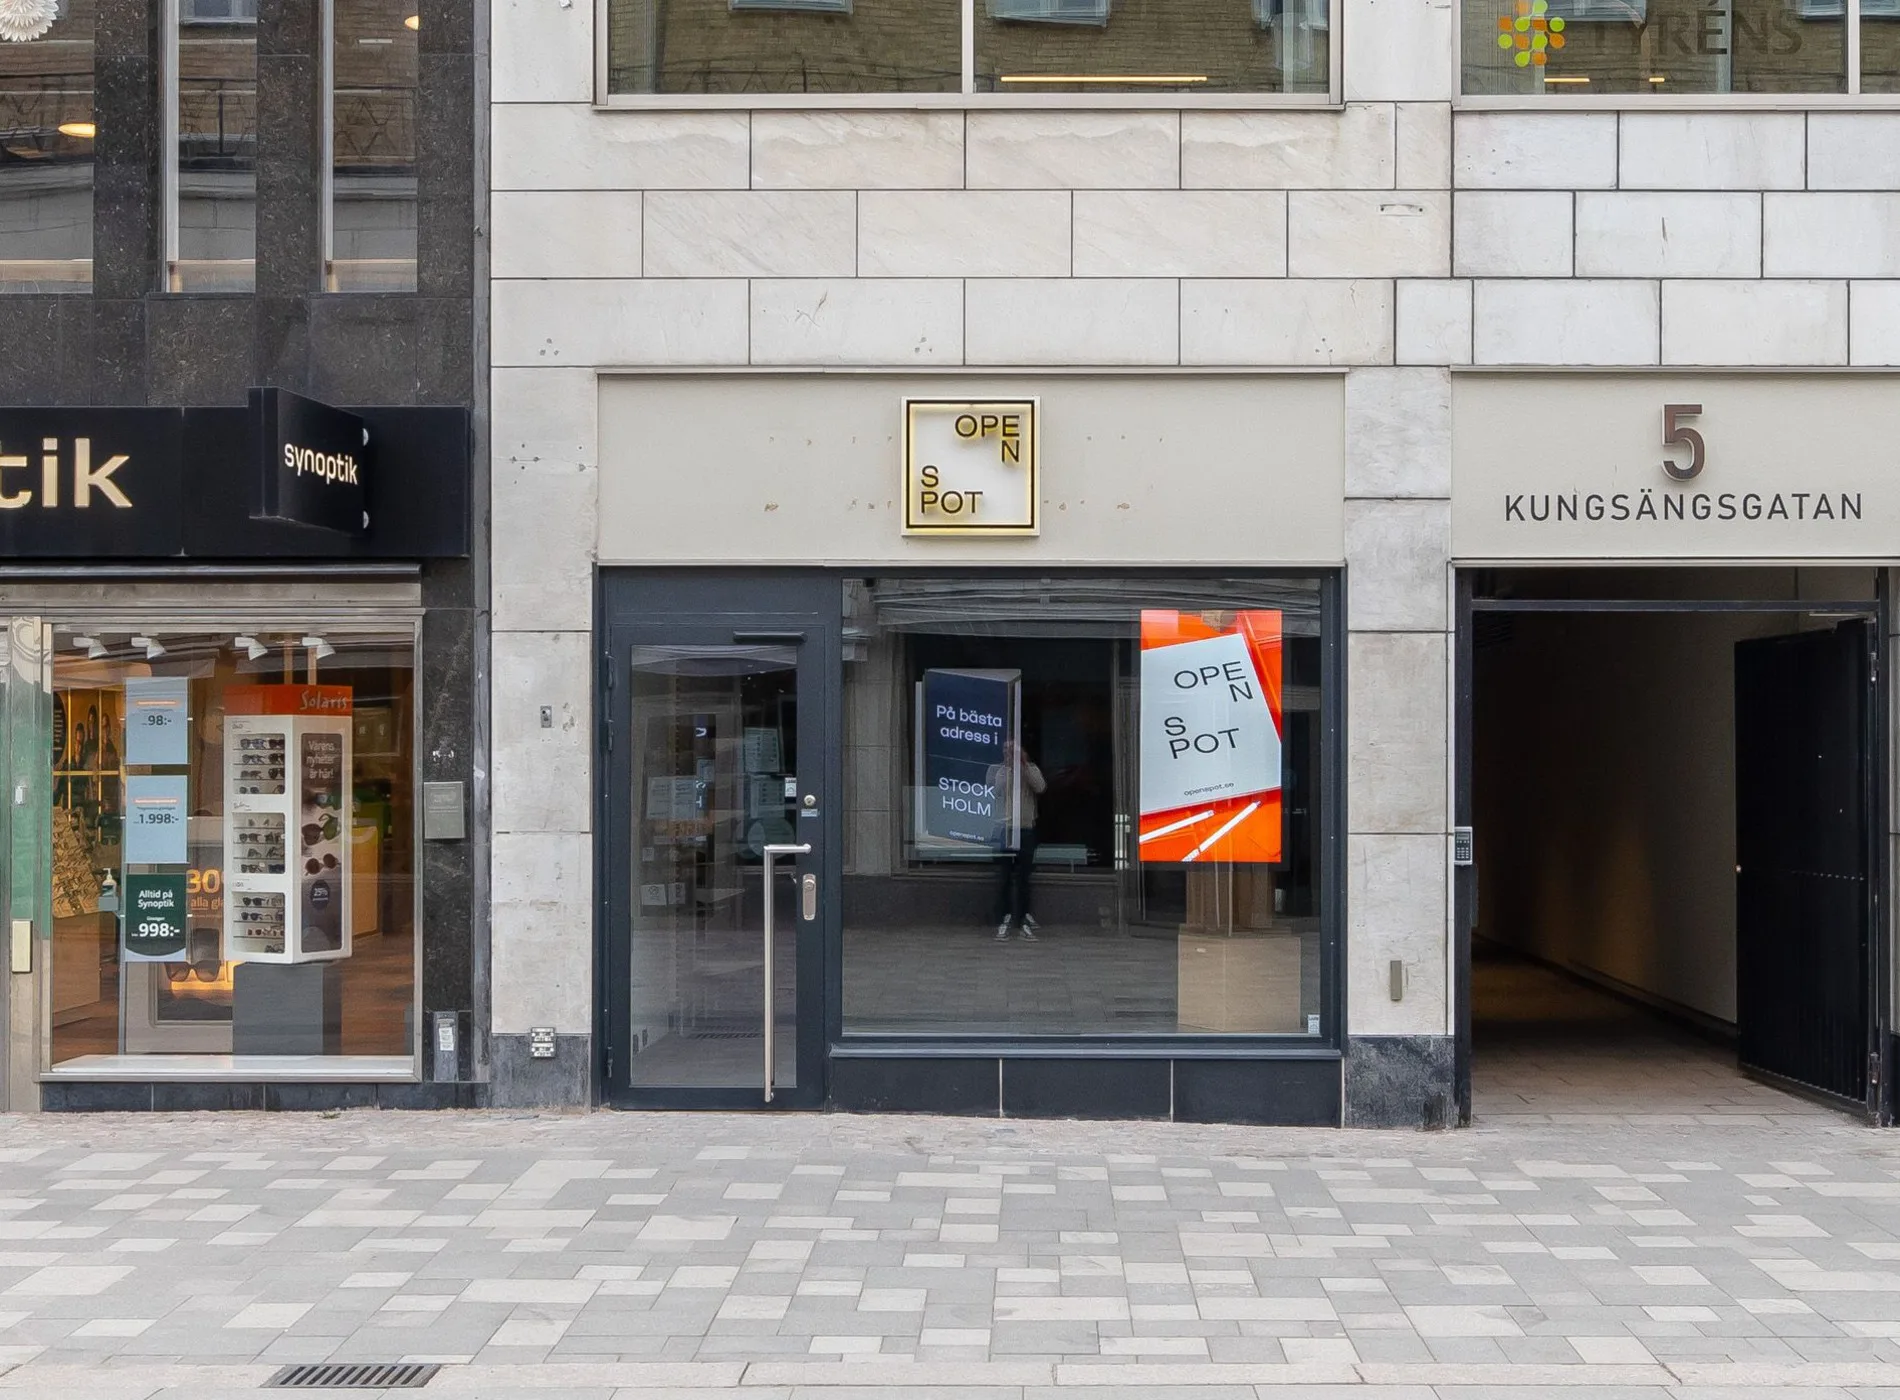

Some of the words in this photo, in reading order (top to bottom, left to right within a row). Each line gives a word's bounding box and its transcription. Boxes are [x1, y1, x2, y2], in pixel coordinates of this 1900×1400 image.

[1661, 404, 1706, 482] 5
[284, 442, 358, 486] synoptik
[1504, 488, 1863, 522] KUNGSÄNGSGATAN
[300, 689, 347, 710] Solaris
[936, 704, 957, 721] På
[959, 708, 1002, 728] bästa
[940, 725, 991, 745] adress
[993, 731, 999, 746] i
[938, 777, 996, 800] STOCK
[1183, 782, 1235, 797] openspot.se
[942, 796, 992, 817] HOLM
[139, 813, 180, 825] 1.998:-
[185, 868, 224, 894] 30
[138, 889, 161, 899] Alltid
[162, 889, 173, 900] på
[138, 899, 175, 910] Synoptik
[138, 922, 180, 938] 998:-
